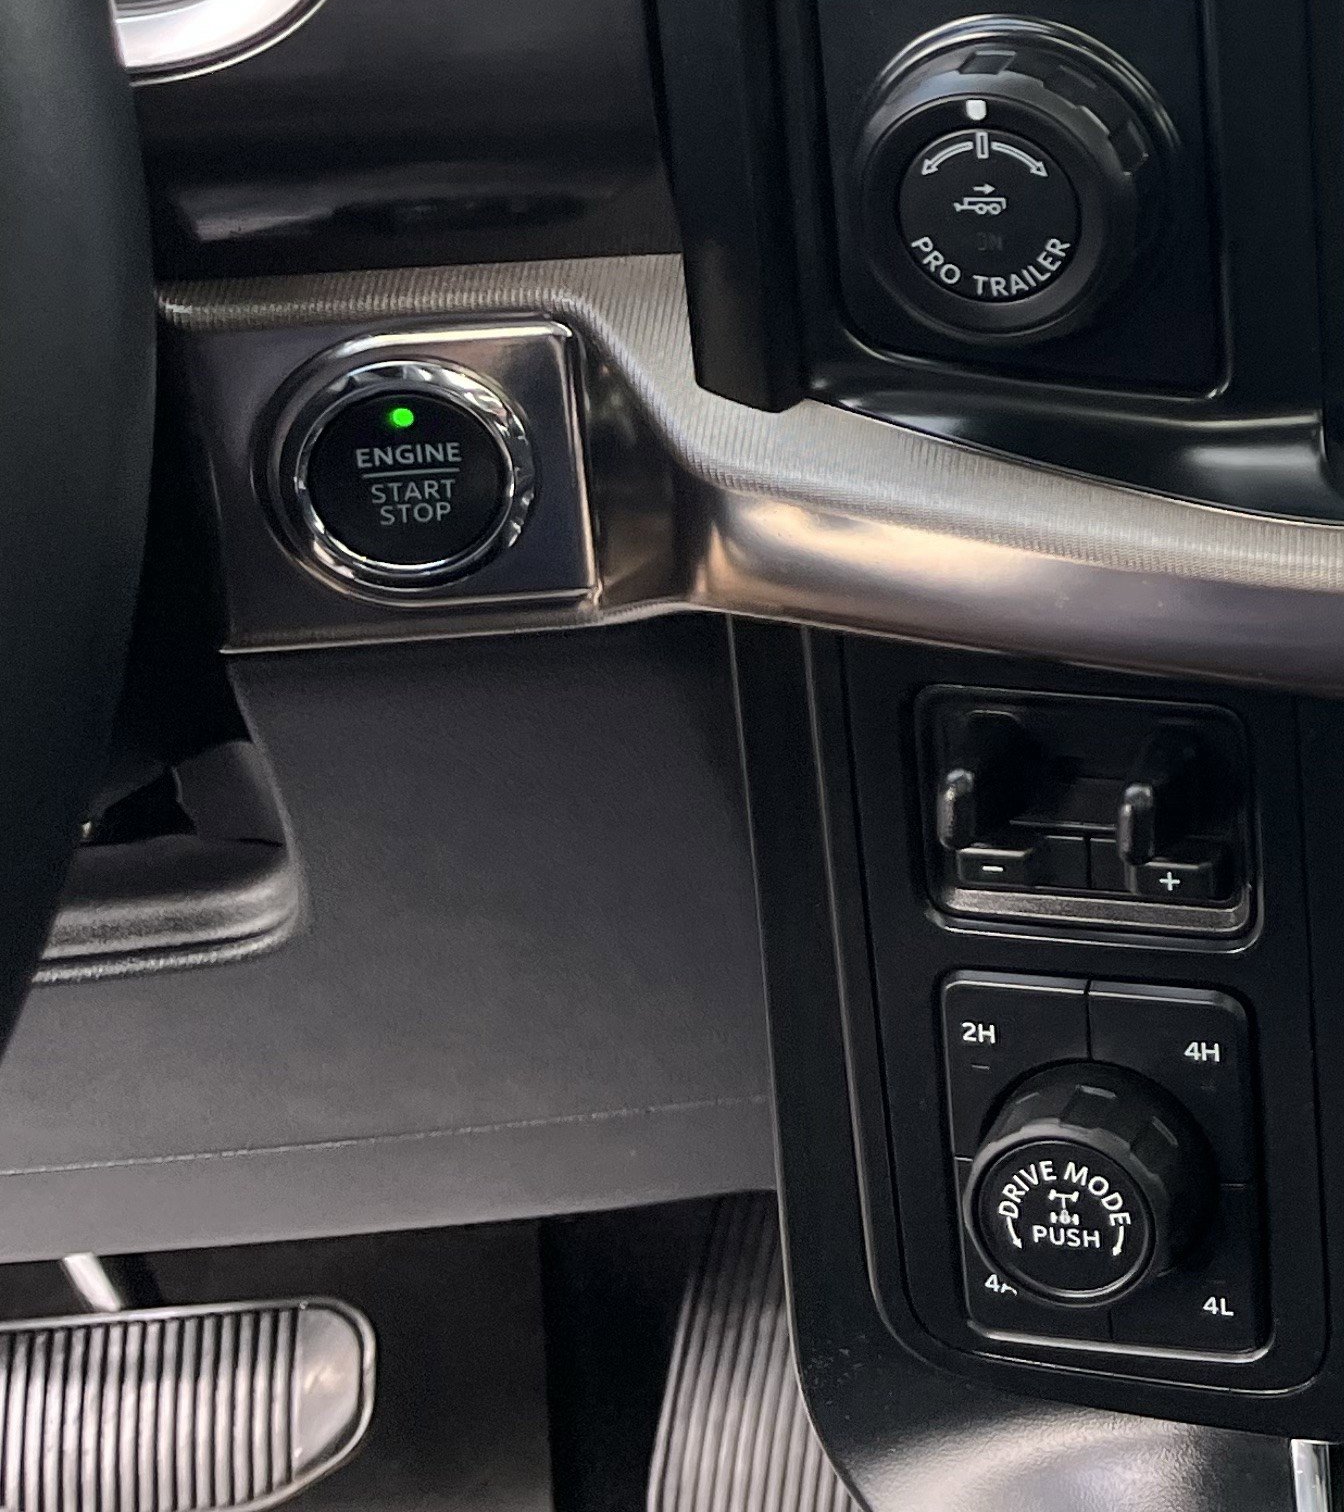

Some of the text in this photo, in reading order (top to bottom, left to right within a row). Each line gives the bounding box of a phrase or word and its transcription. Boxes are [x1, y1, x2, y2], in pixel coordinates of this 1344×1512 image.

[911, 236, 1071, 297] PRO TRAILER
[355, 442, 463, 469] ENGINE
[370, 479, 456, 504] START
[380, 501, 451, 526] STOP
[962, 1022, 997, 1044] 2H
[1183, 1041, 1221, 1063] 4H
[998, 1160, 1132, 1226] DRIVE MODE
[1032, 1225, 1101, 1249] PUSH
[1202, 1296, 1234, 1316] 4L
